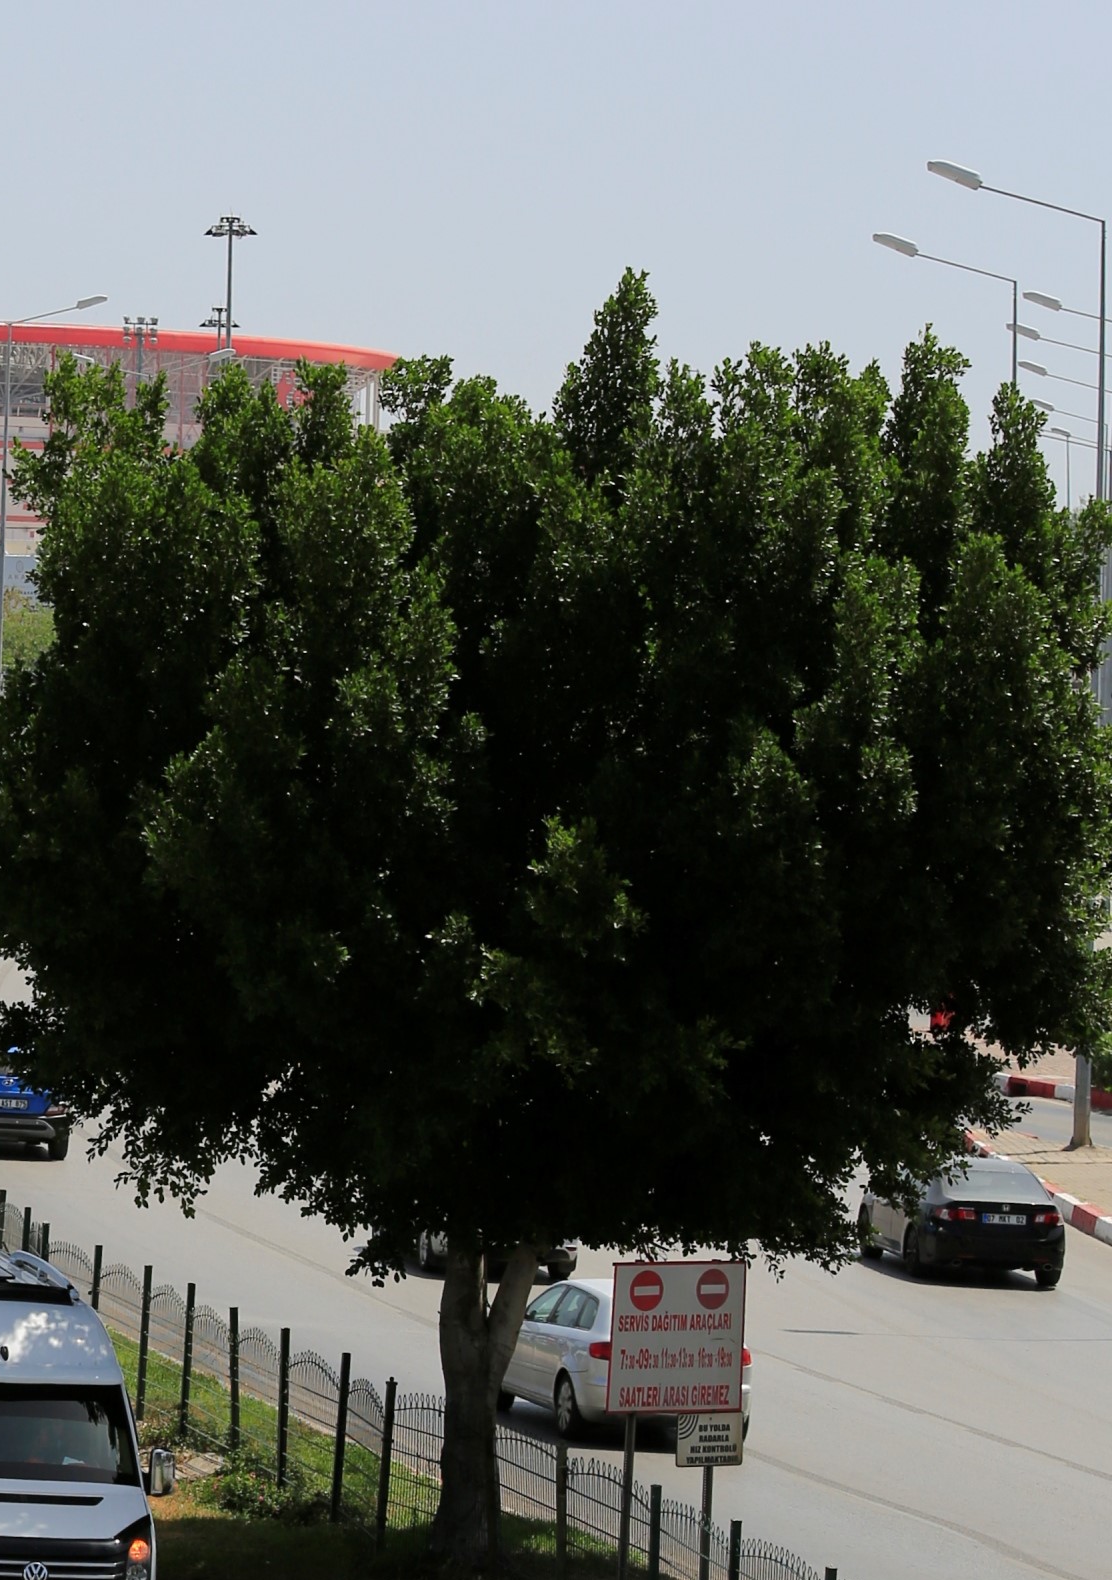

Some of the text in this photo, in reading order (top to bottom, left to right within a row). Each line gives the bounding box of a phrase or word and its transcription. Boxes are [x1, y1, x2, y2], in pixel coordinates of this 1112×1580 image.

[618, 1311, 732, 1335] SERVİS DAĞITIM ARAÇLARI
[619, 1383, 730, 1408] SAATLERİ ARASI GİREMEZ
[698, 1423, 730, 1433] BU YOLDA
[698, 1434, 729, 1443] RADARLA
[690, 1445, 701, 1454] HIZ
